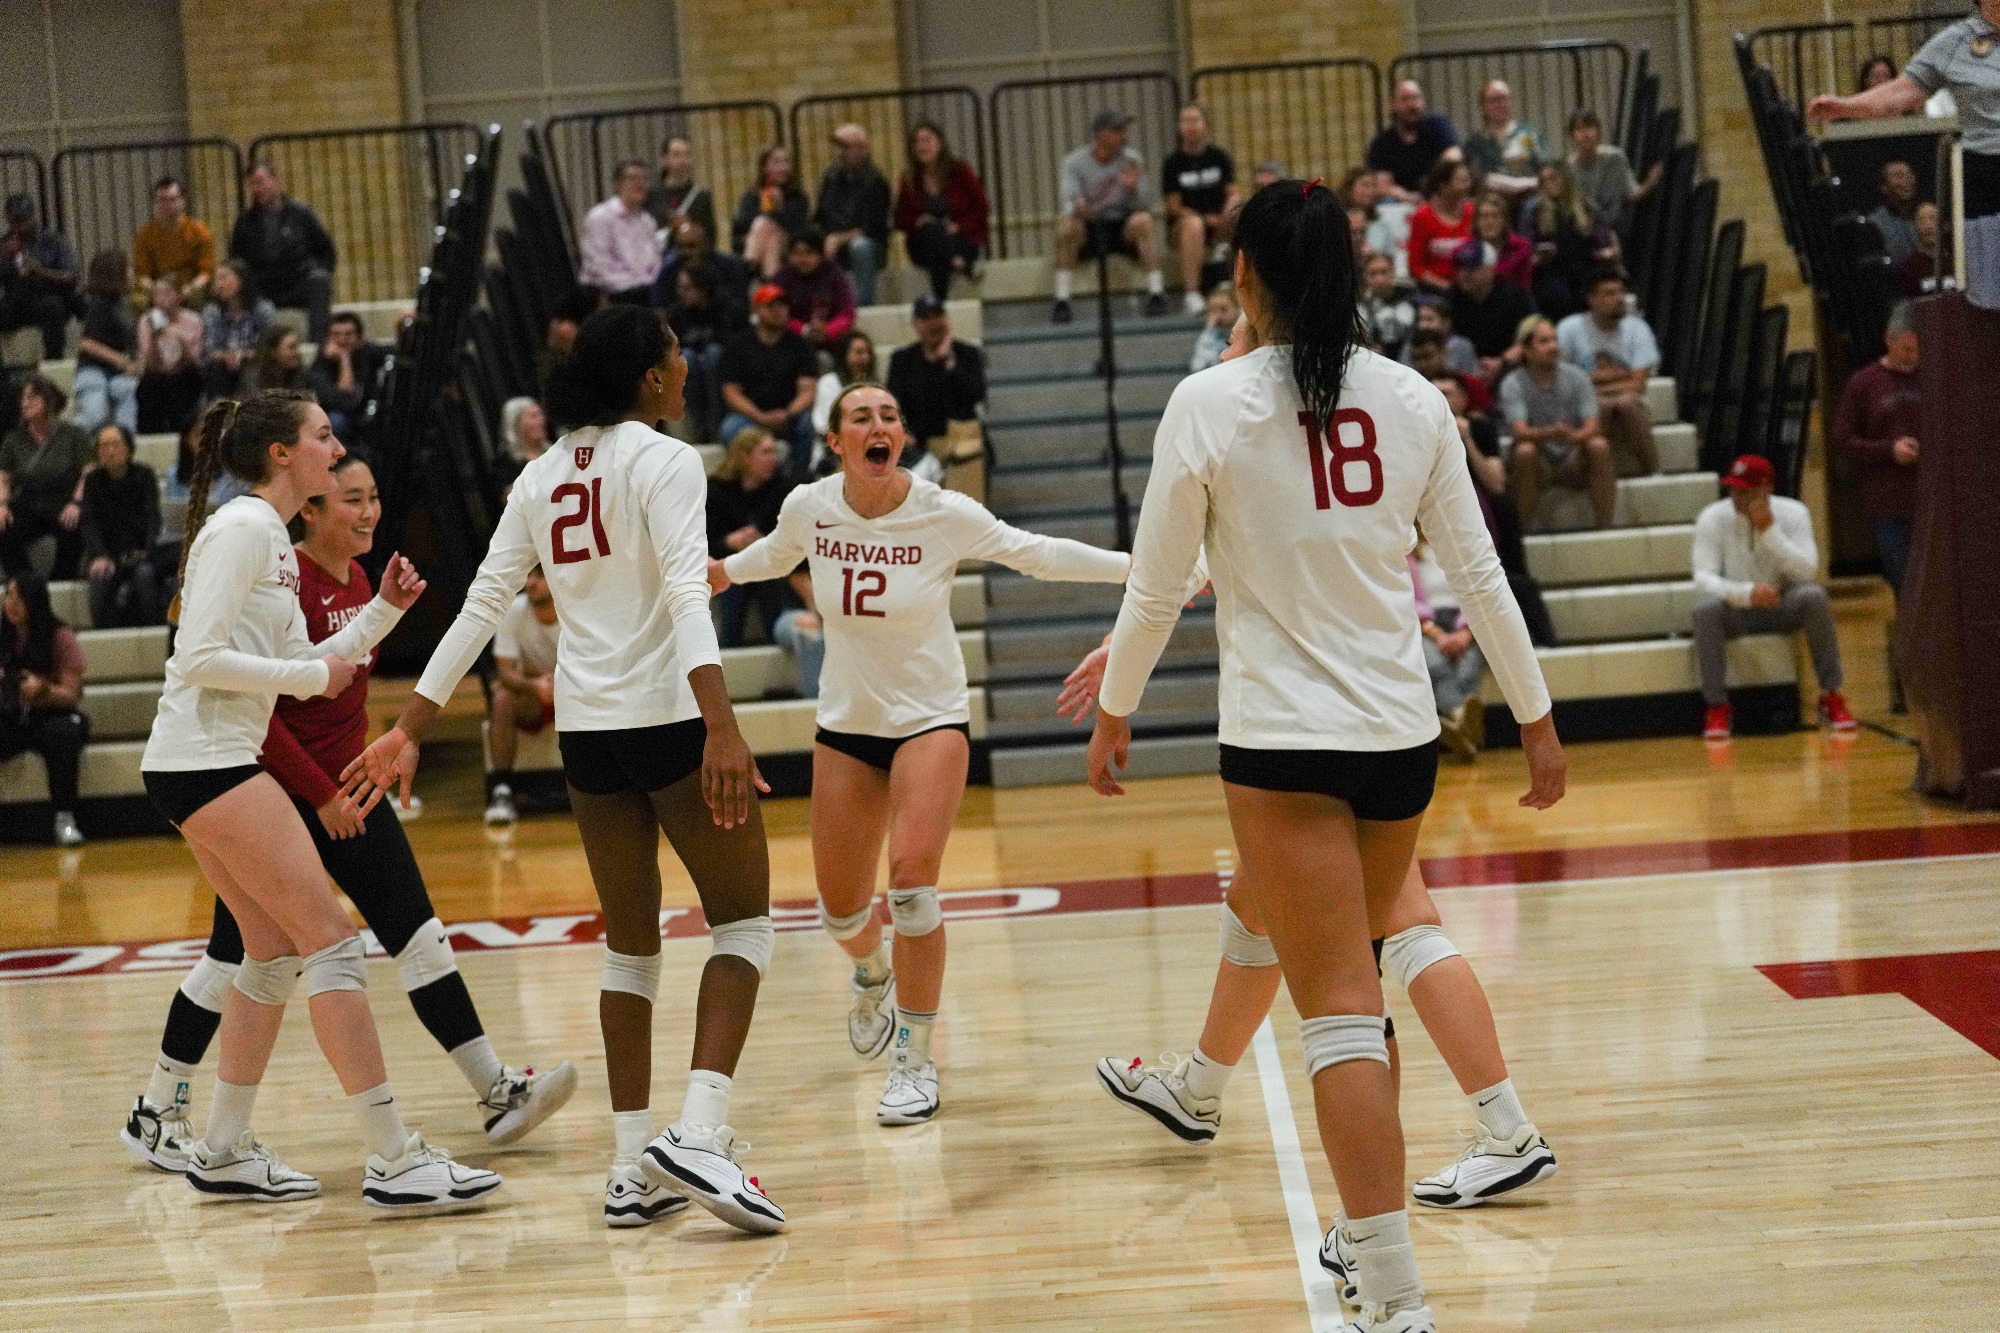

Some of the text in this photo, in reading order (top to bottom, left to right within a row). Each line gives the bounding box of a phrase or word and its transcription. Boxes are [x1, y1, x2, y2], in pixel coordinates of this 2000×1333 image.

[577, 448, 592, 465] H
[1297, 407, 1384, 511] 18
[550, 477, 611, 564] 21
[815, 536, 922, 565] HARVARD
[842, 567, 887, 618] 12
